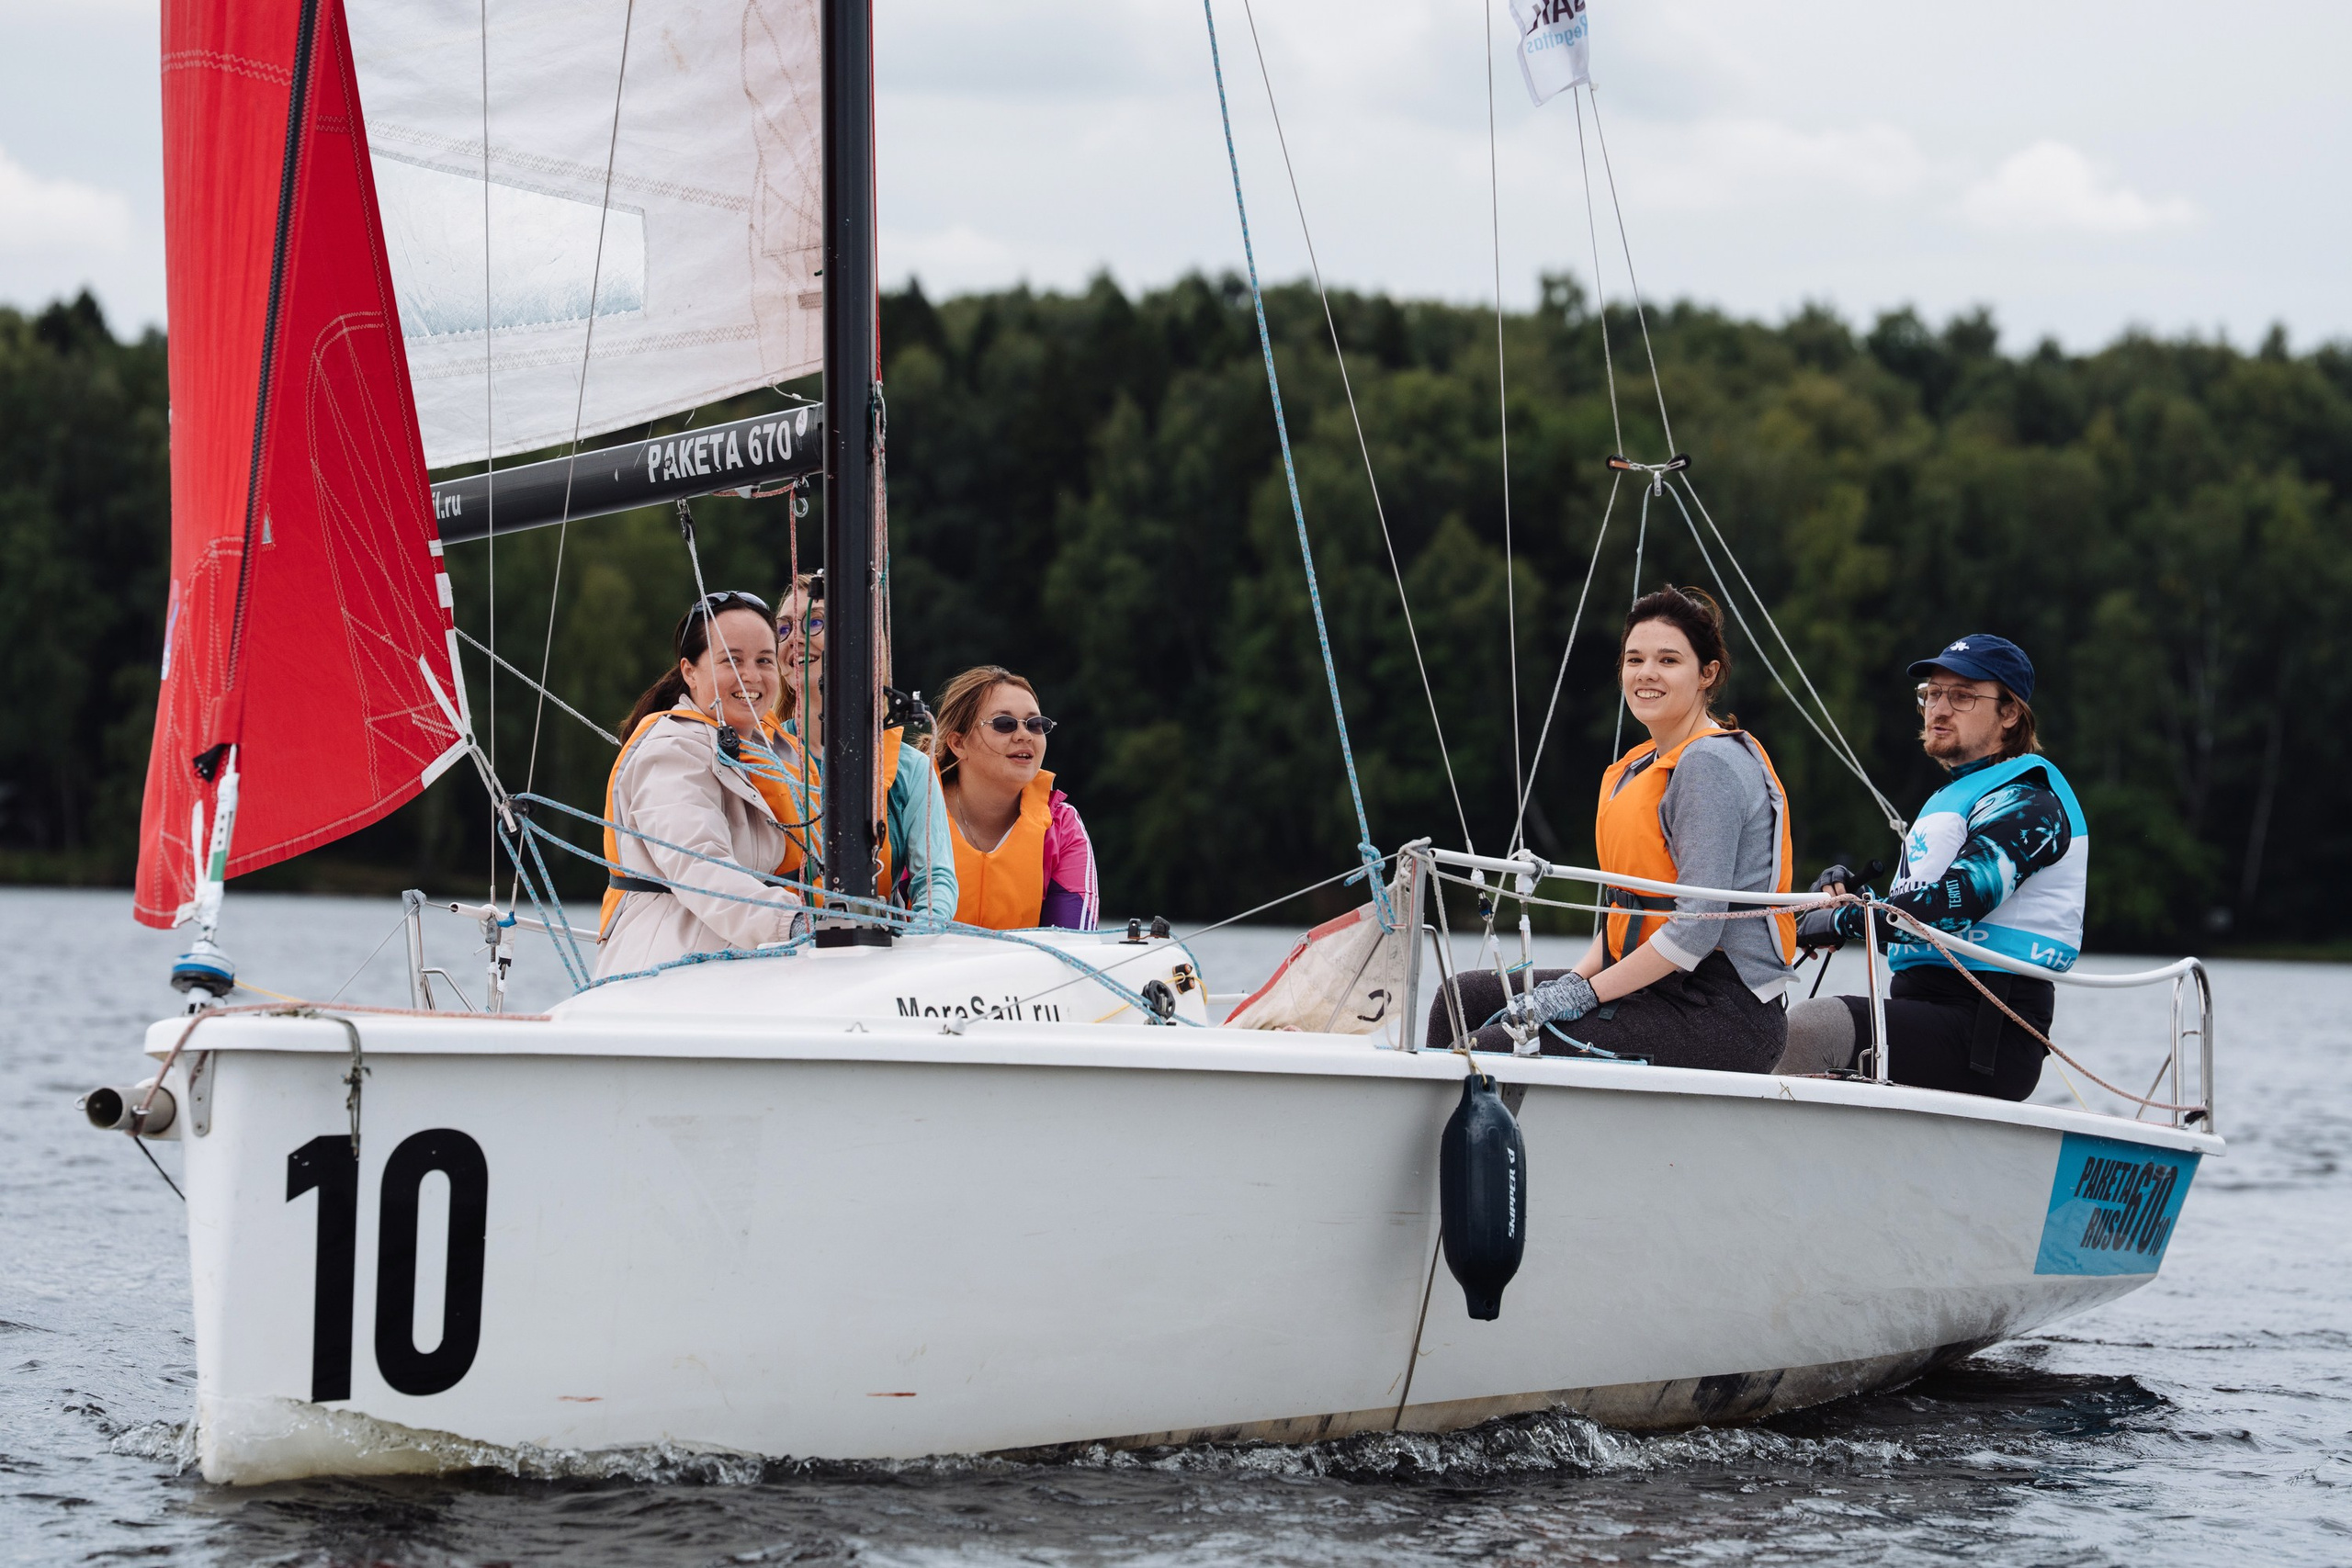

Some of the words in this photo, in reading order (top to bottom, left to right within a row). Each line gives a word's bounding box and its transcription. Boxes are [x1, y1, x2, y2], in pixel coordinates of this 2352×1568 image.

[748, 420, 792, 466] 670
[1945, 879, 1962, 909] TERMIT
[1508, 1168, 1516, 1239] SKIPPER
[2080, 1207, 2121, 1251] RUS
[2148, 1216, 2171, 1257] 10
[2112, 1161, 2178, 1255] 670
[285, 1127, 489, 1403] 10
